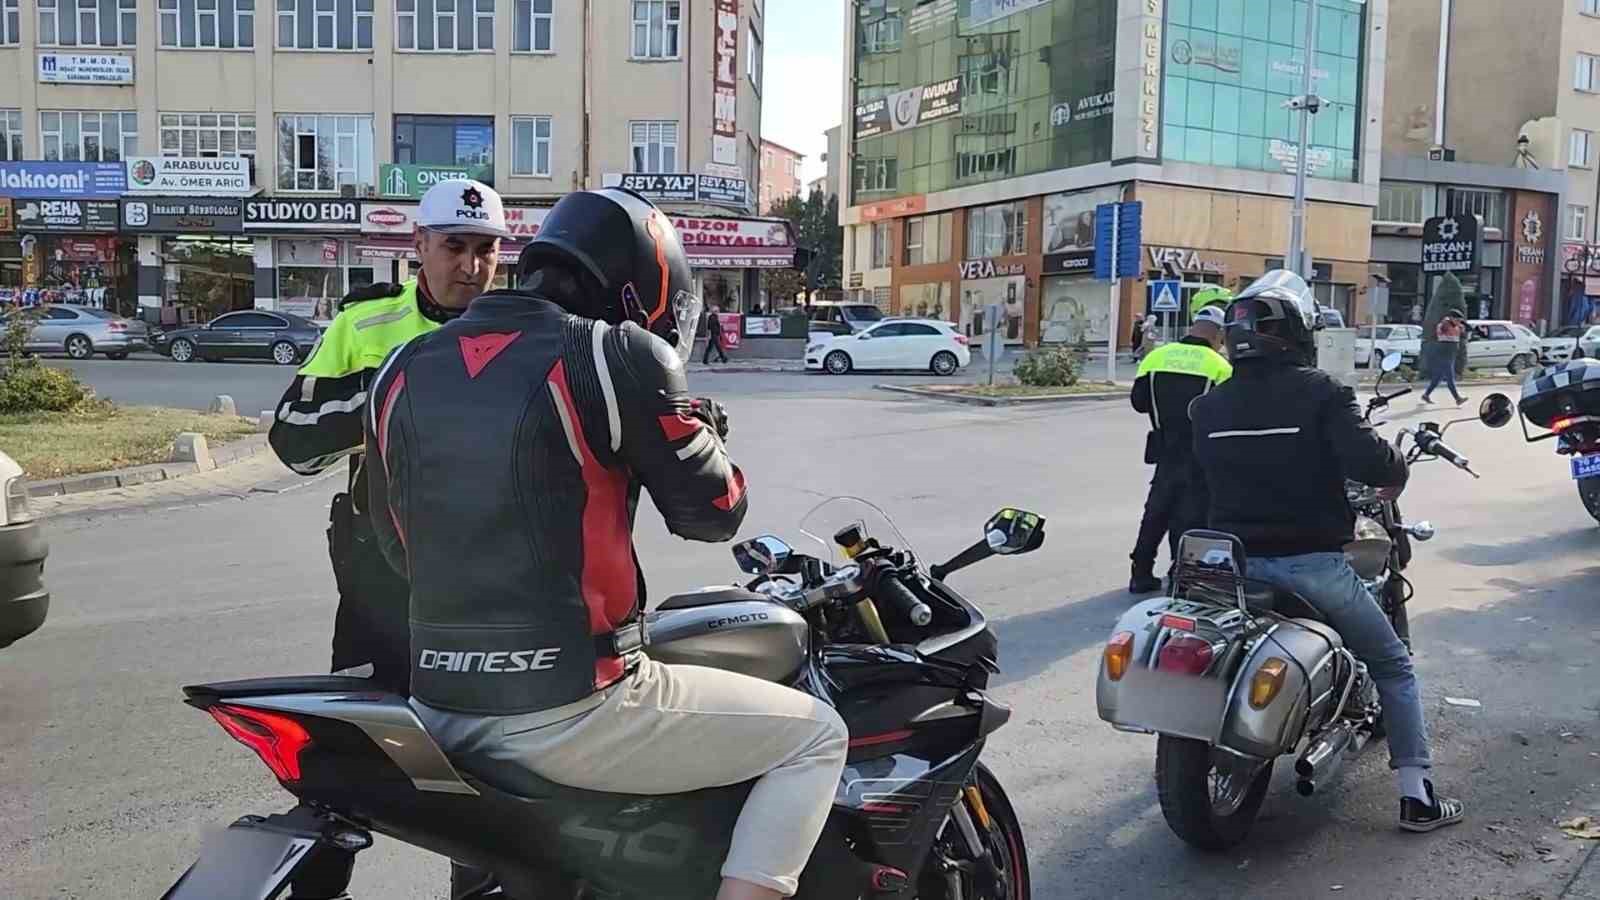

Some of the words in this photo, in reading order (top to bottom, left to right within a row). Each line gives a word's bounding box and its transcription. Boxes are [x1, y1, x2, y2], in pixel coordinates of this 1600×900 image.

[922, 79, 960, 100] AVUKAT
[163, 160, 240, 170] ARABULUCU
[624, 176, 694, 190] SEV-YAP
[700, 175, 744, 190] SEV-YAP
[41, 200, 81, 216] REHA
[247, 199, 317, 220] STÜDYO
[321, 202, 356, 220] EDA
[673, 219, 738, 232] ABZON
[683, 231, 763, 247] DÜNYASI
[959, 260, 996, 279] VERA
[707, 612, 769, 629] CFMOTO
[418, 647, 561, 673] DAINESE
